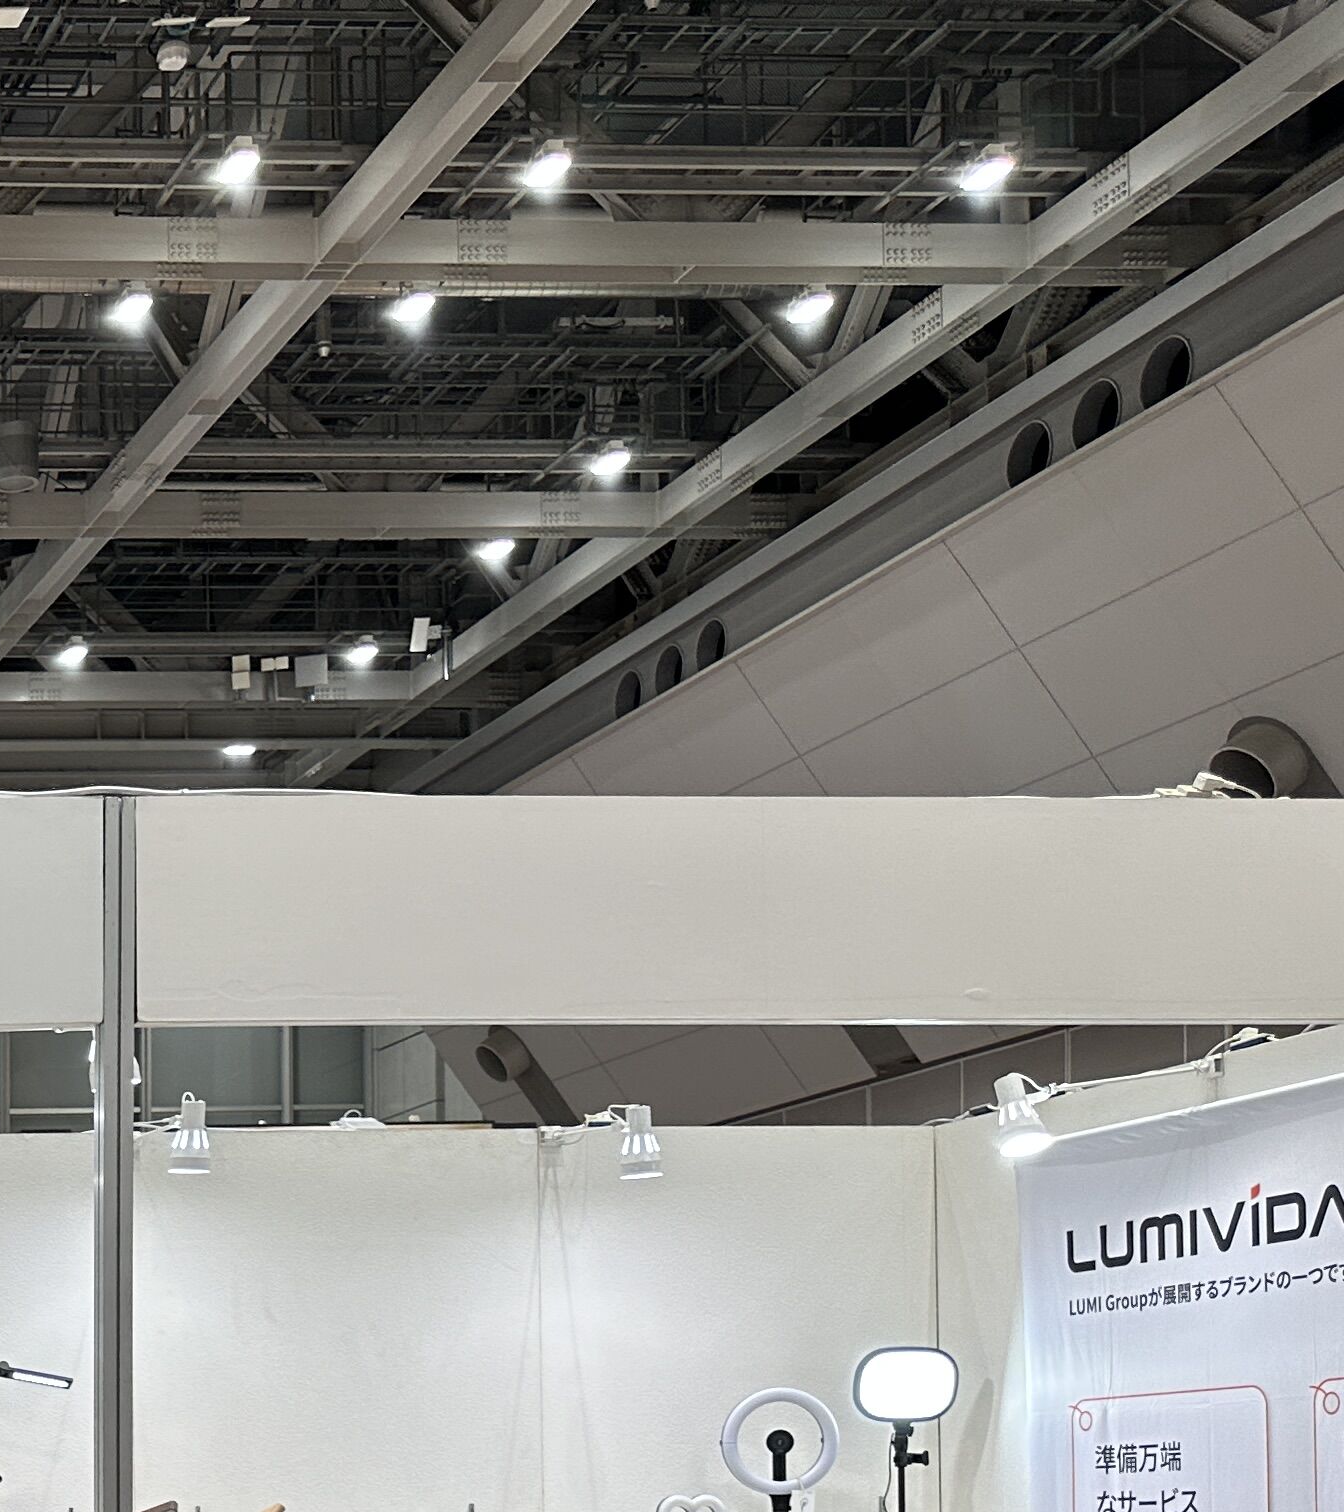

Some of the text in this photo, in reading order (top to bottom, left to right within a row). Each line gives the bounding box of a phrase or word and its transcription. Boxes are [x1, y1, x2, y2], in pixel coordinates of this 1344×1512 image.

[1069, 1296, 1102, 1316] LUMI
[1095, 1441, 1182, 1475] 準備万端
